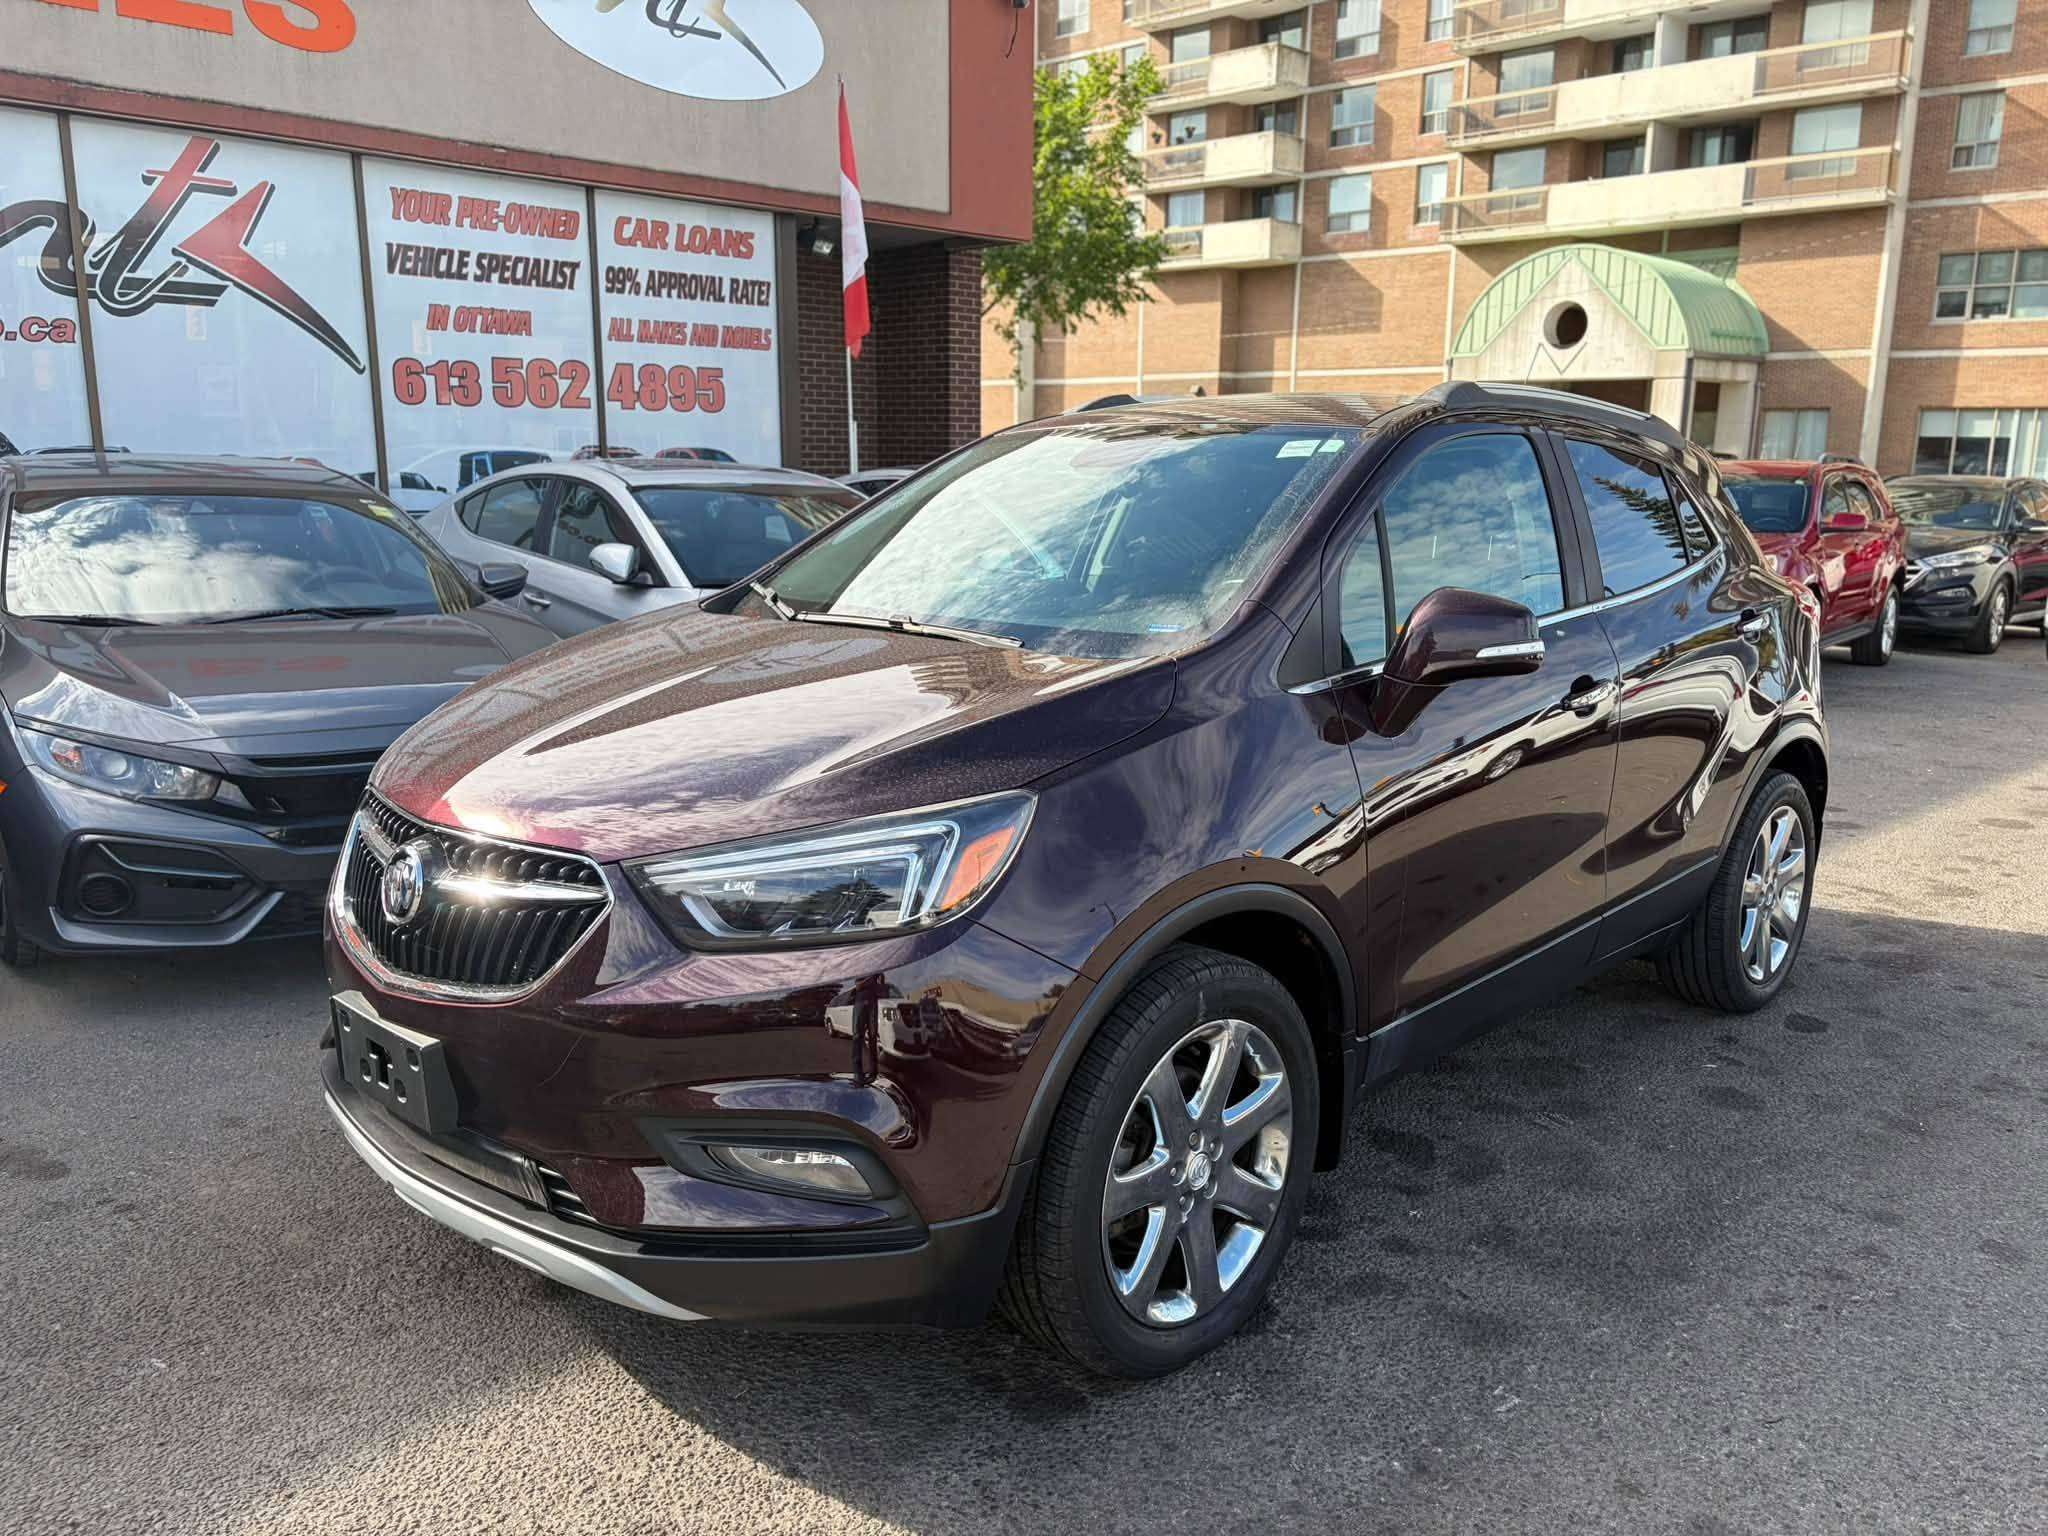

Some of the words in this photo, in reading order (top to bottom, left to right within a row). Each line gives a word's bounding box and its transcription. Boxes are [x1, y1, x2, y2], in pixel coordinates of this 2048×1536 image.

[389, 186, 451, 226] YOUR
[455, 195, 580, 241] PRE-OWNED
[613, 216, 669, 250] CAR
[674, 223, 755, 260] LOANS
[386, 242, 471, 281] VEHICLE
[473, 252, 581, 290] SPECIALIST
[605, 265, 641, 296] 99%
[645, 269, 726, 303] APPROVAL
[729, 277, 771, 306] RATE!
[426, 303, 450, 331] IN
[453, 305, 533, 336] OTTAWA
[607, 317, 634, 342] ALL
[637, 319, 688, 345] MAKES
[689, 323, 719, 348] AND
[720, 325, 772, 351] MODELS
[392, 357, 482, 407] 613
[491, 356, 591, 409] 562
[607, 362, 726, 413] 4895
